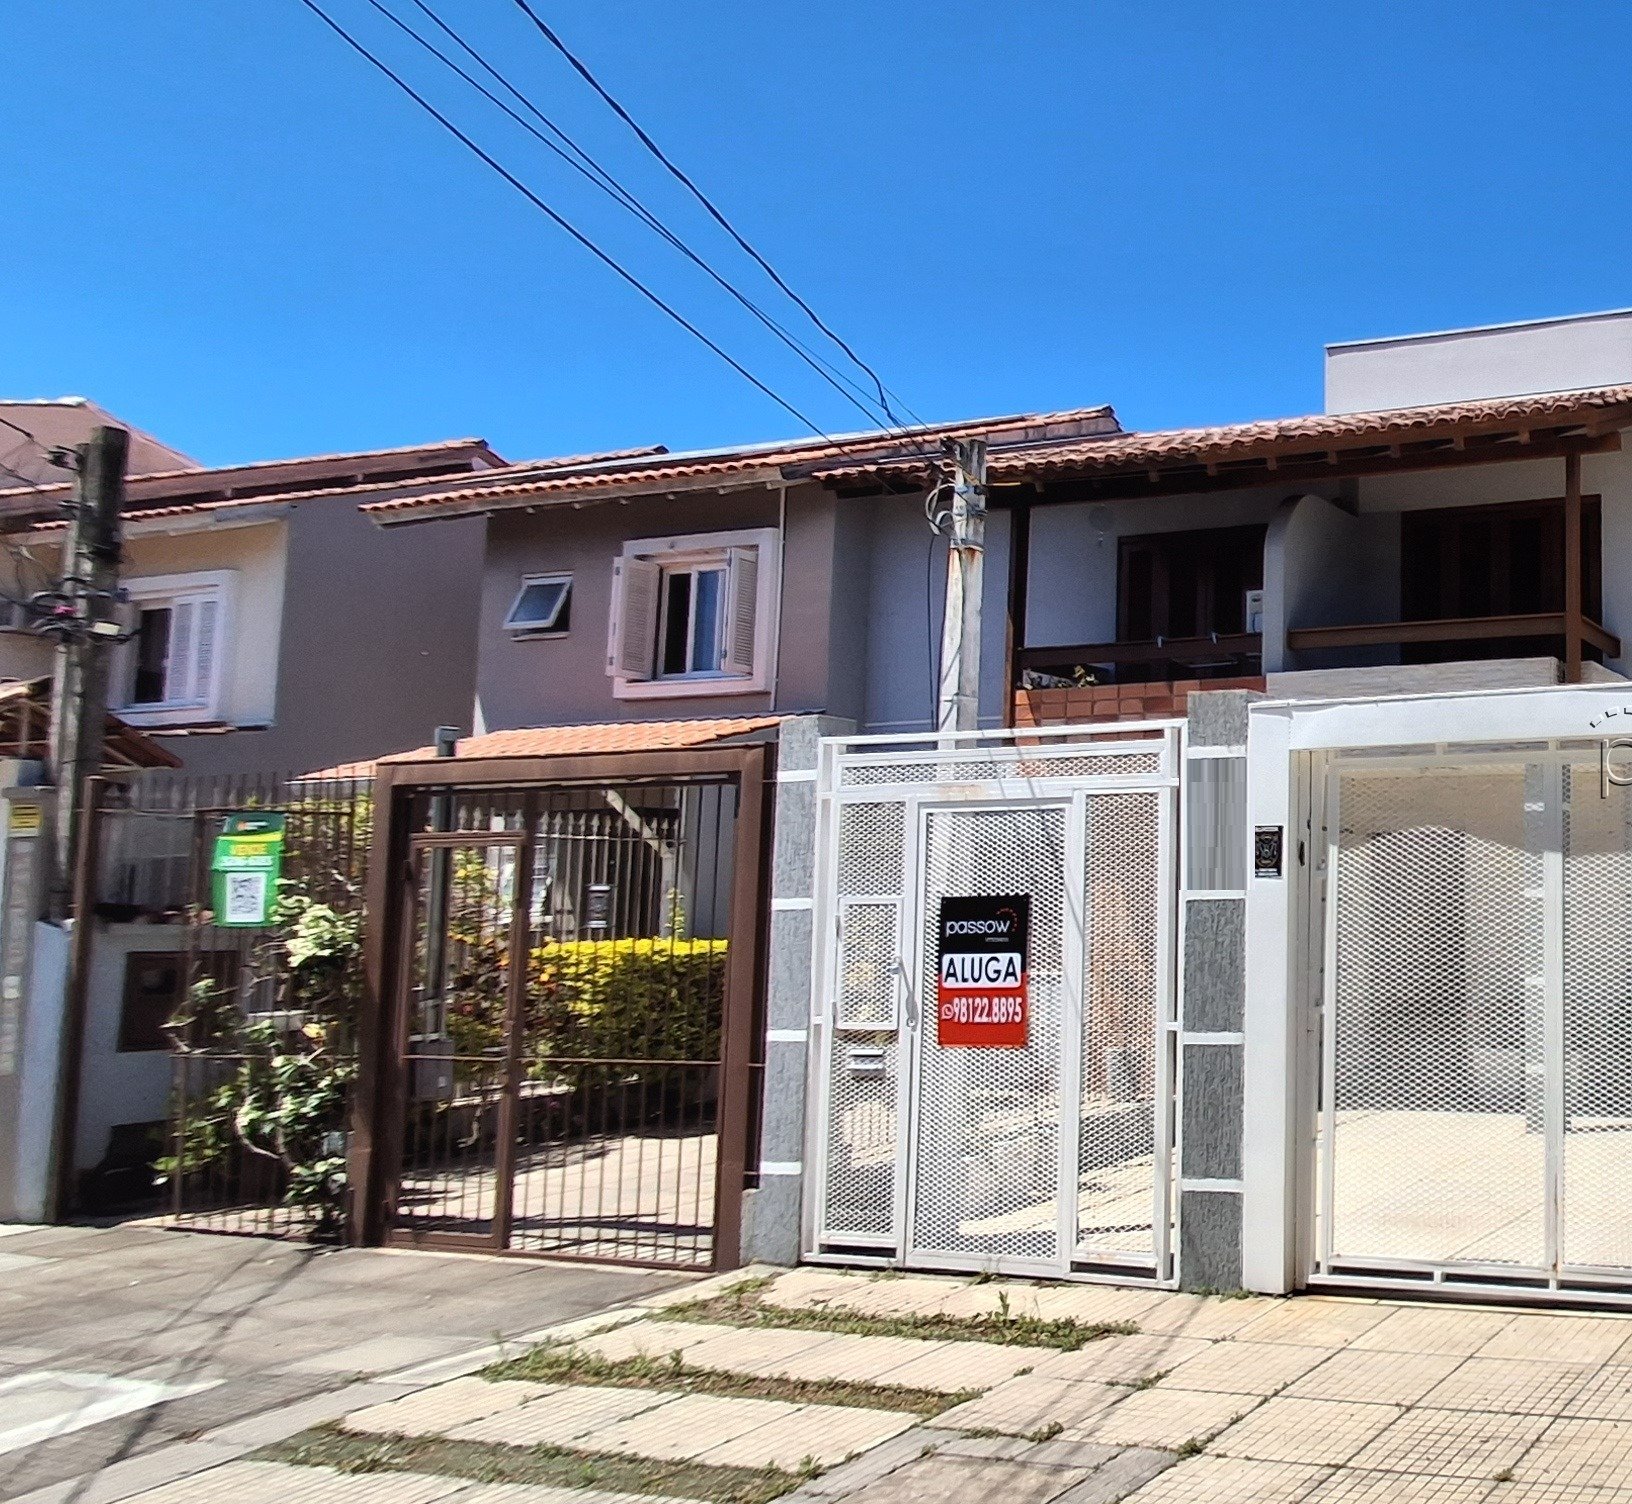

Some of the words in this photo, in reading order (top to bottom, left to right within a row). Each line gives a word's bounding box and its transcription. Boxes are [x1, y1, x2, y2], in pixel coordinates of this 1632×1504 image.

[946, 920, 1010, 937] passow
[944, 956, 1018, 983] ALUGA
[953, 997, 1022, 1023] 98122.8895
